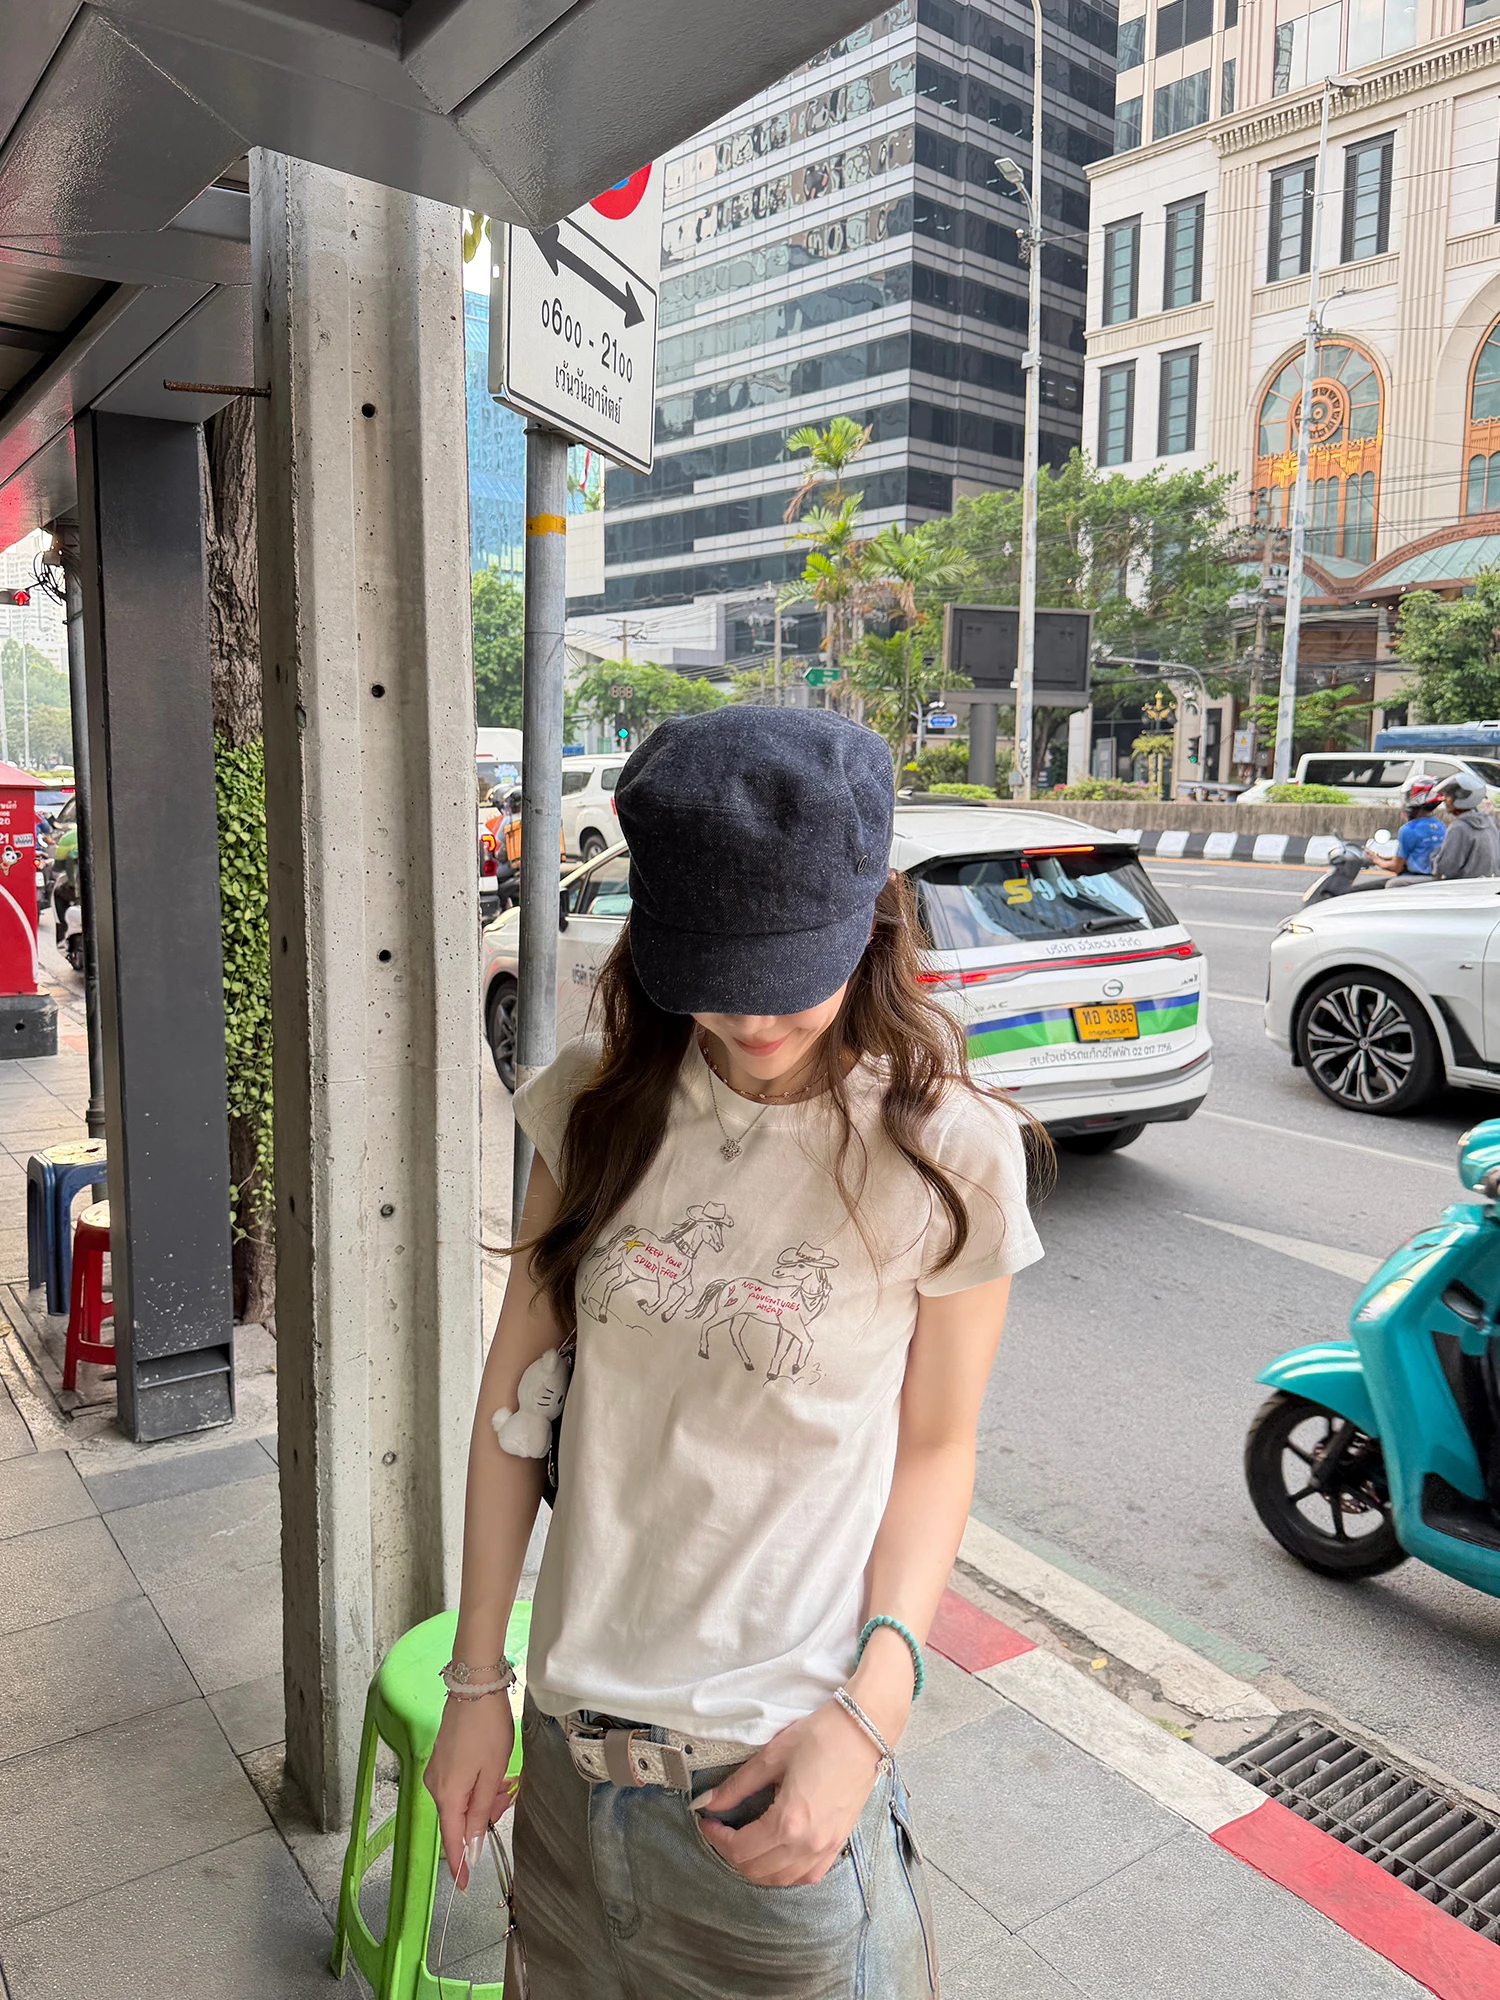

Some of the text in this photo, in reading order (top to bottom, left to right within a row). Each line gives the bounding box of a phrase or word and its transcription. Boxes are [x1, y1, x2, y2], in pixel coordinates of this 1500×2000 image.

[541, 297, 583, 349] 0600
[600, 332, 633, 384] 2100
[554, 360, 623, 425] เว้นวันอาทิตย์
[1105, 1008, 1135, 1024] 3885
[645, 1243, 665, 1258] KEEP
[634, 1254, 678, 1280] SPIRIT FREE
[742, 1281, 763, 1292] NEW
[748, 1292, 801, 1312] ADVENTURES
[756, 1303, 784, 1318] AHEAD
